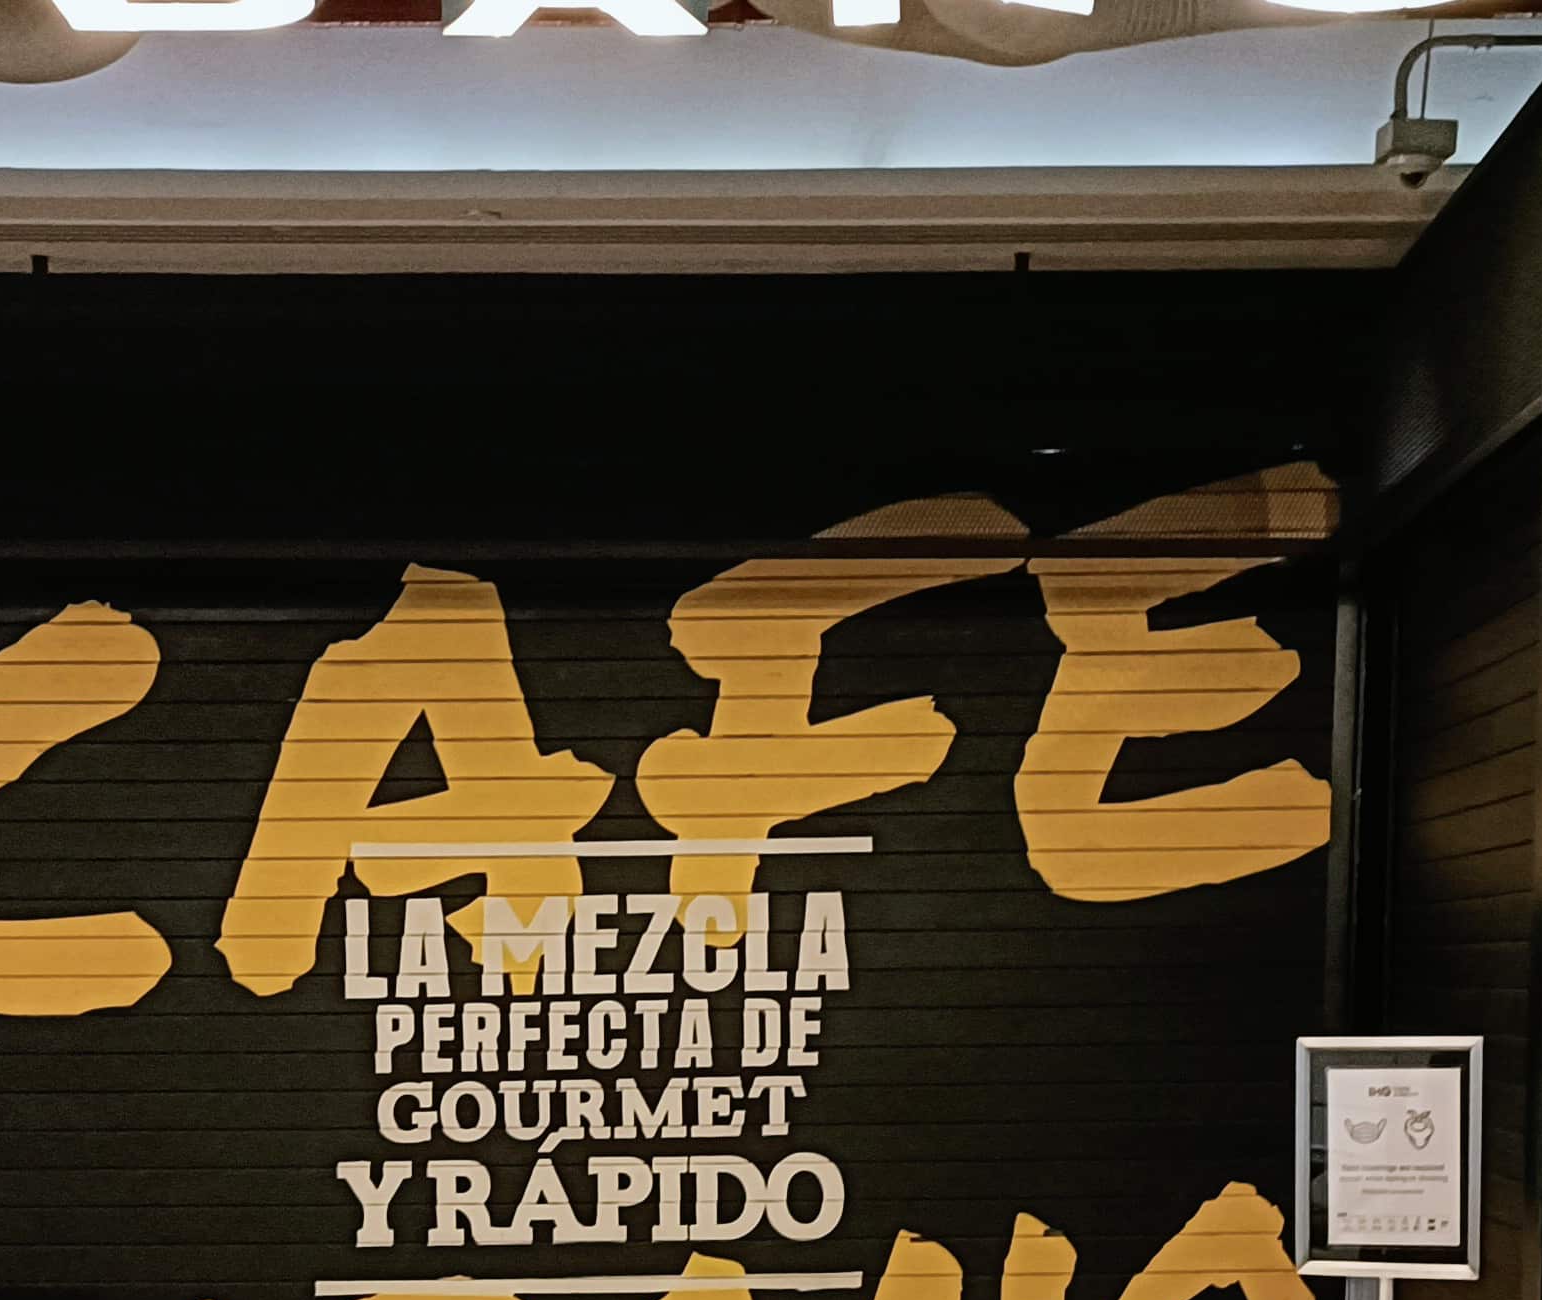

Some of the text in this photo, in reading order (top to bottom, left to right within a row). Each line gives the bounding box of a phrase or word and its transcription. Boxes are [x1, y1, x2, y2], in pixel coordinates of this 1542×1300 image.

[345, 891, 850, 999] LA MEZCLA
[374, 996, 822, 1074] PERFECTA DE
[377, 1075, 807, 1144] GOURMET
[336, 1131, 845, 1248] Y RÁPIDO
